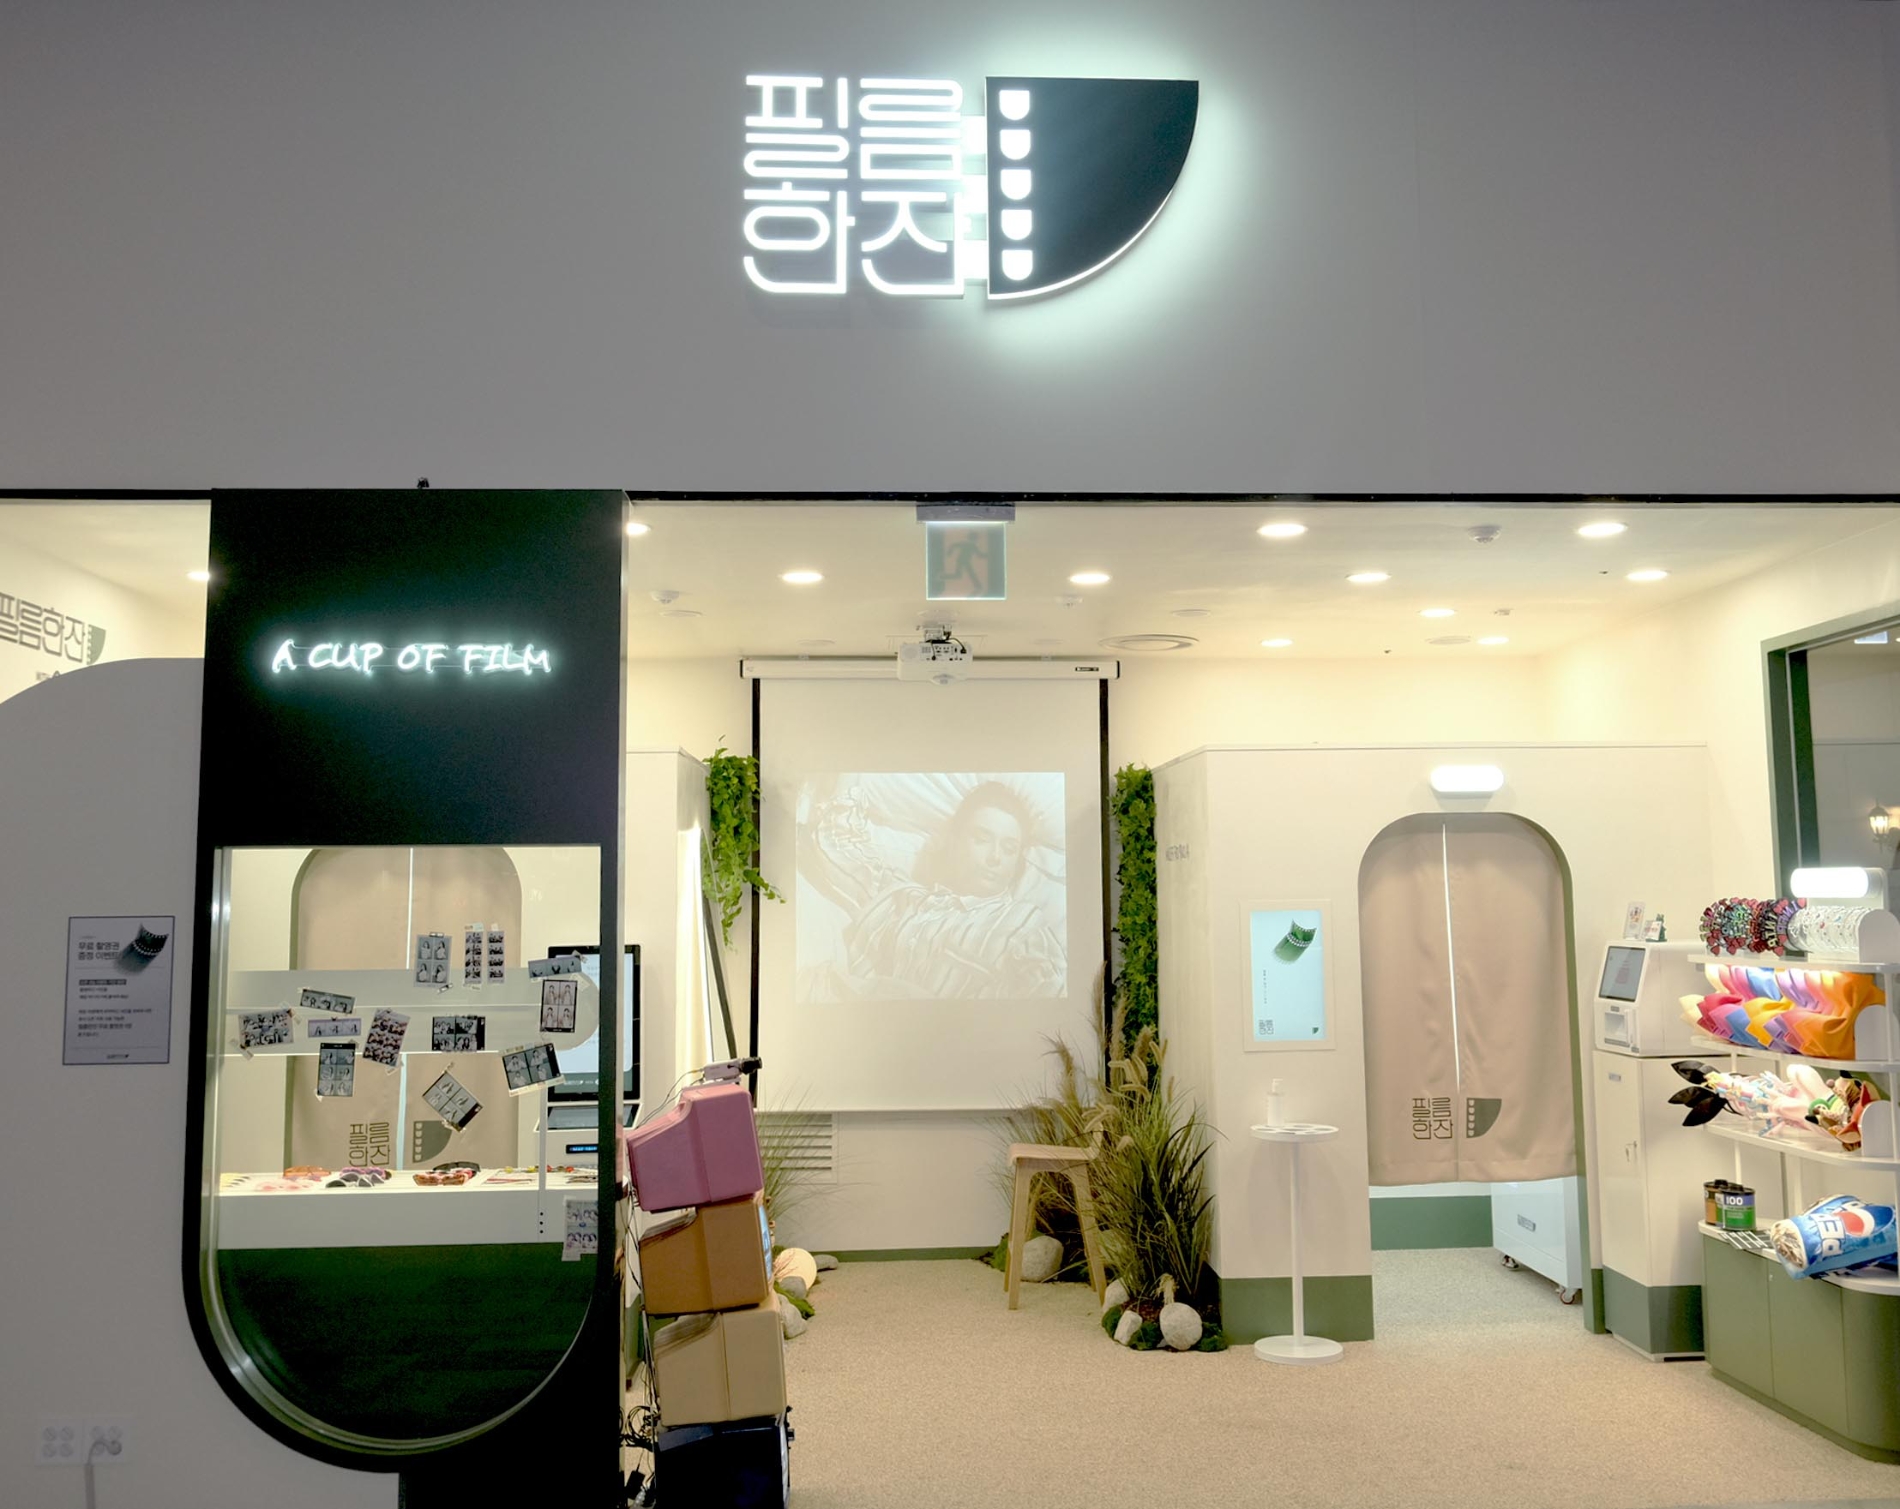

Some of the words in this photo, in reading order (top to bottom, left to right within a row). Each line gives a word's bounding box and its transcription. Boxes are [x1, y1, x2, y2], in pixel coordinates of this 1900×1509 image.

[744, 74, 964, 180] 필름
[743, 182, 970, 296] 한잔
[272, 638, 298, 674] A
[307, 642, 384, 675] CUP
[397, 643, 448, 674] OF
[456, 643, 552, 675] FILM
[1412, 1097, 1451, 1118] 필름
[349, 1121, 390, 1145] 필름
[1412, 1119, 1453, 1140] 한잔
[348, 1145, 391, 1168] 한잔
[1725, 1196, 1744, 1206] 100
